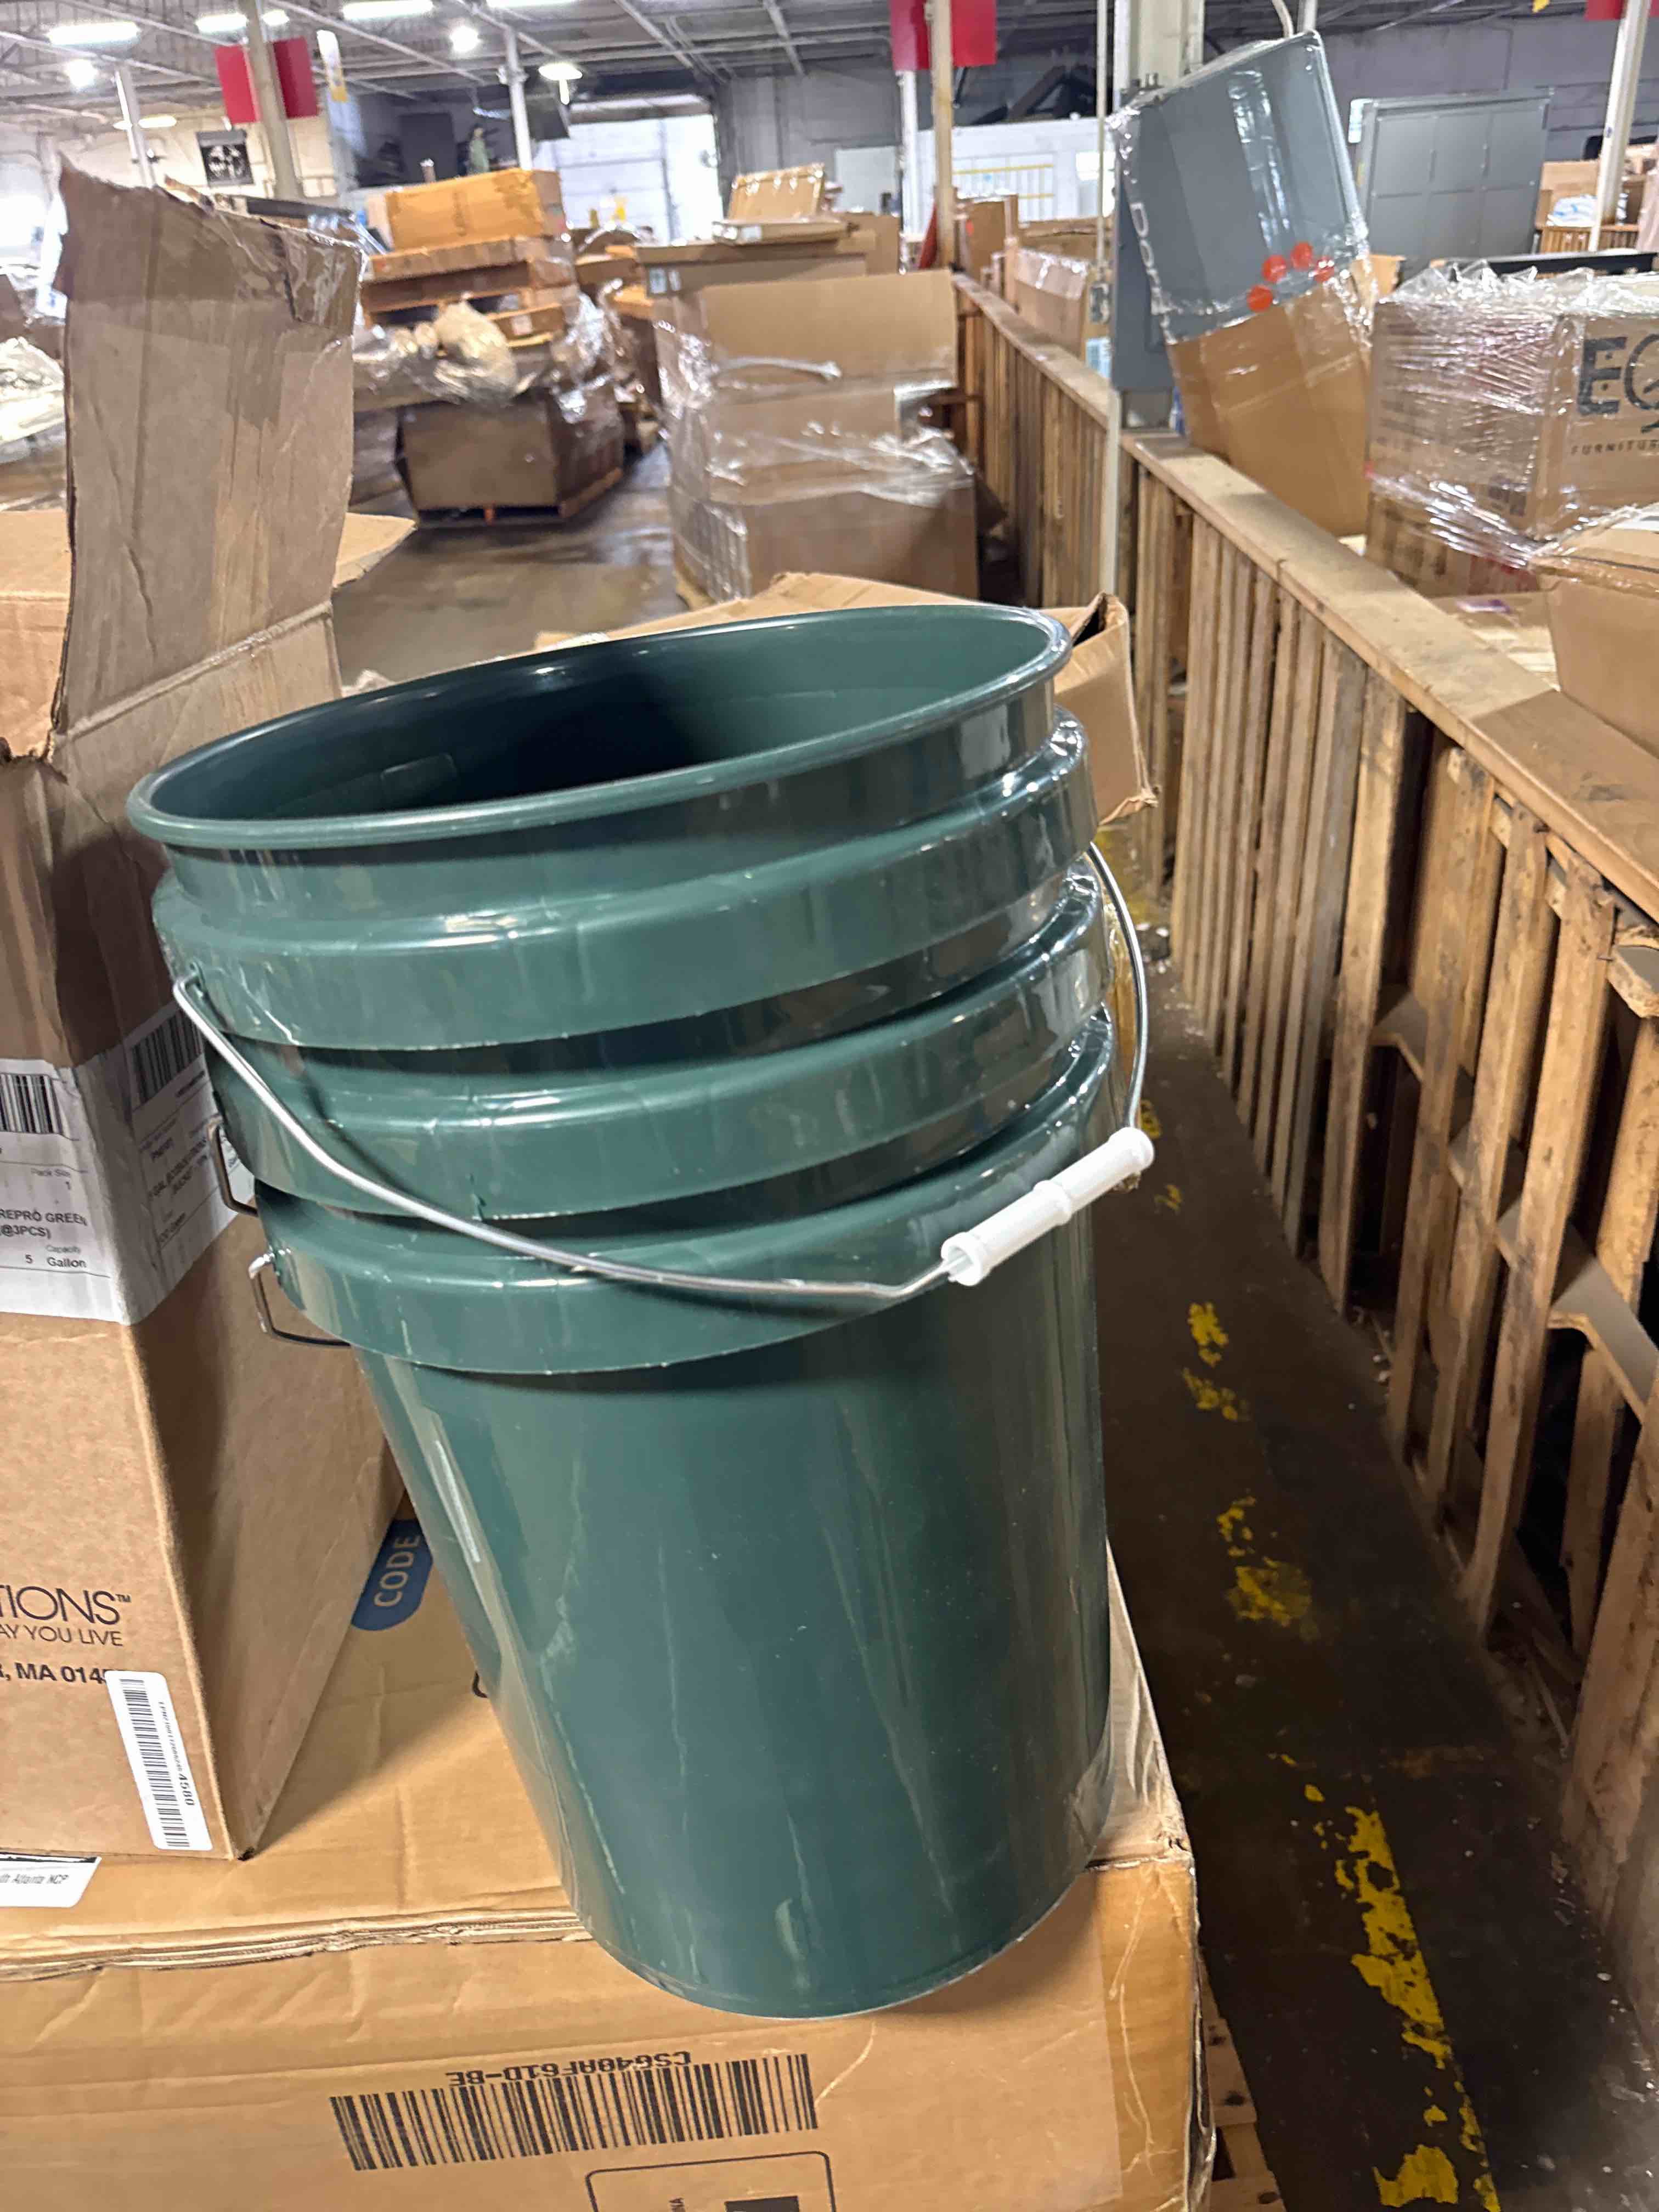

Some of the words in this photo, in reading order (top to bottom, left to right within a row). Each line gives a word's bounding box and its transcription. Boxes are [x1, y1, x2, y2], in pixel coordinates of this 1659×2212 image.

[25, 1254, 33, 1264] 5
[47, 1256, 87, 1269] Gallon
[374, 1535, 421, 1607] CODE
[24, 1624, 71, 1643] YOU
[78, 1628, 123, 1647] LIVE
[14, 1662, 57, 1681] MA
